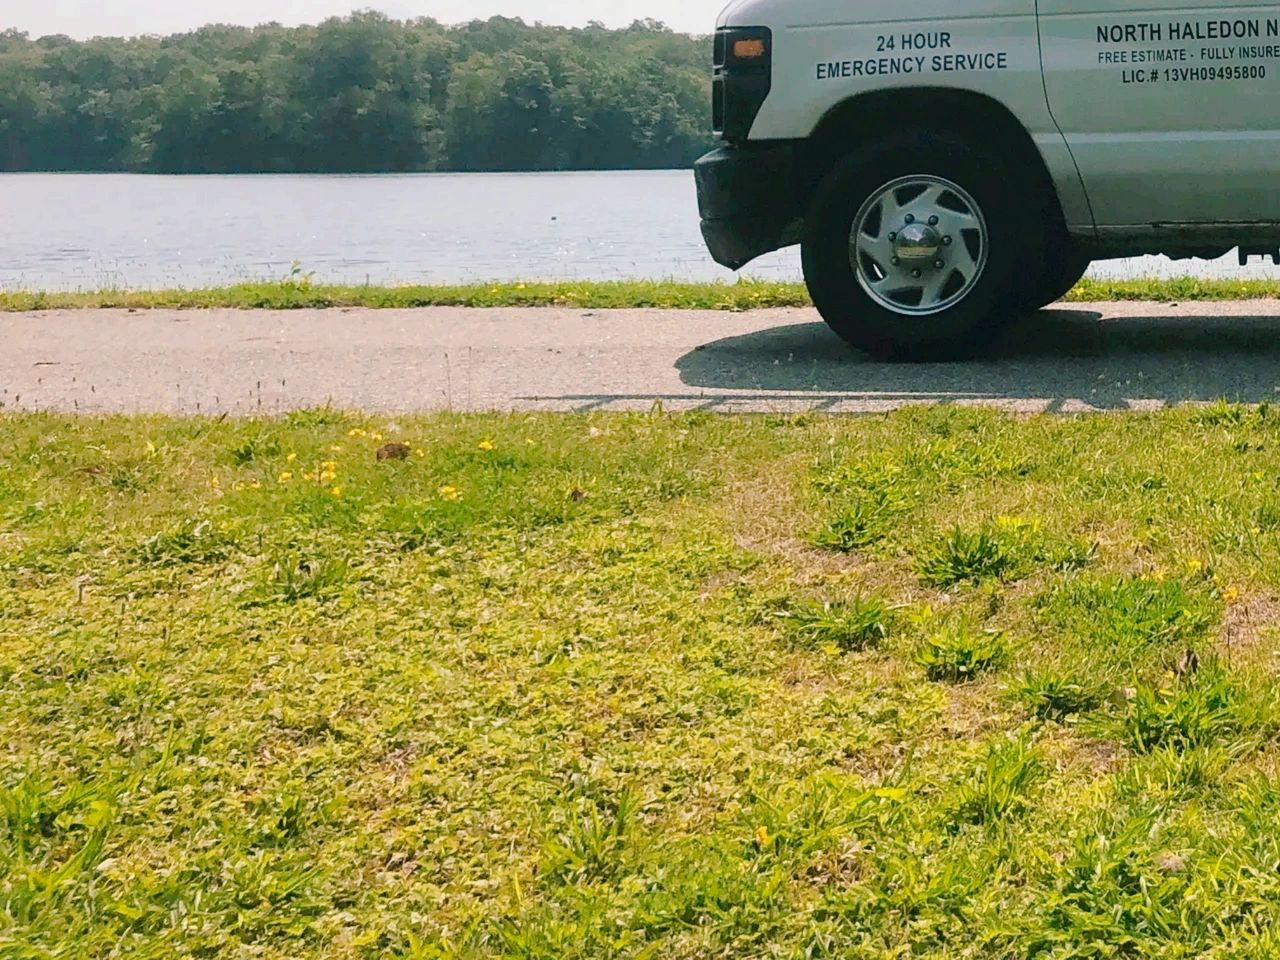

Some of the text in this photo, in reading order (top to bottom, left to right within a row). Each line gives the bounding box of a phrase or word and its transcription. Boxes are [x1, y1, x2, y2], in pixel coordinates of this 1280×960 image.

[876, 31, 952, 52] 24 HOUR
[1096, 23, 1162, 43] NORTH
[1168, 19, 1259, 41] HALEDON
[1098, 51, 1128, 64] FREE
[1131, 48, 1186, 63] ESTIMATE
[1200, 46, 1235, 60] FULLY
[816, 52, 1008, 80] EMERGENCY SERVICE
[1122, 65, 1267, 84] LIC.# 13VH09495800
